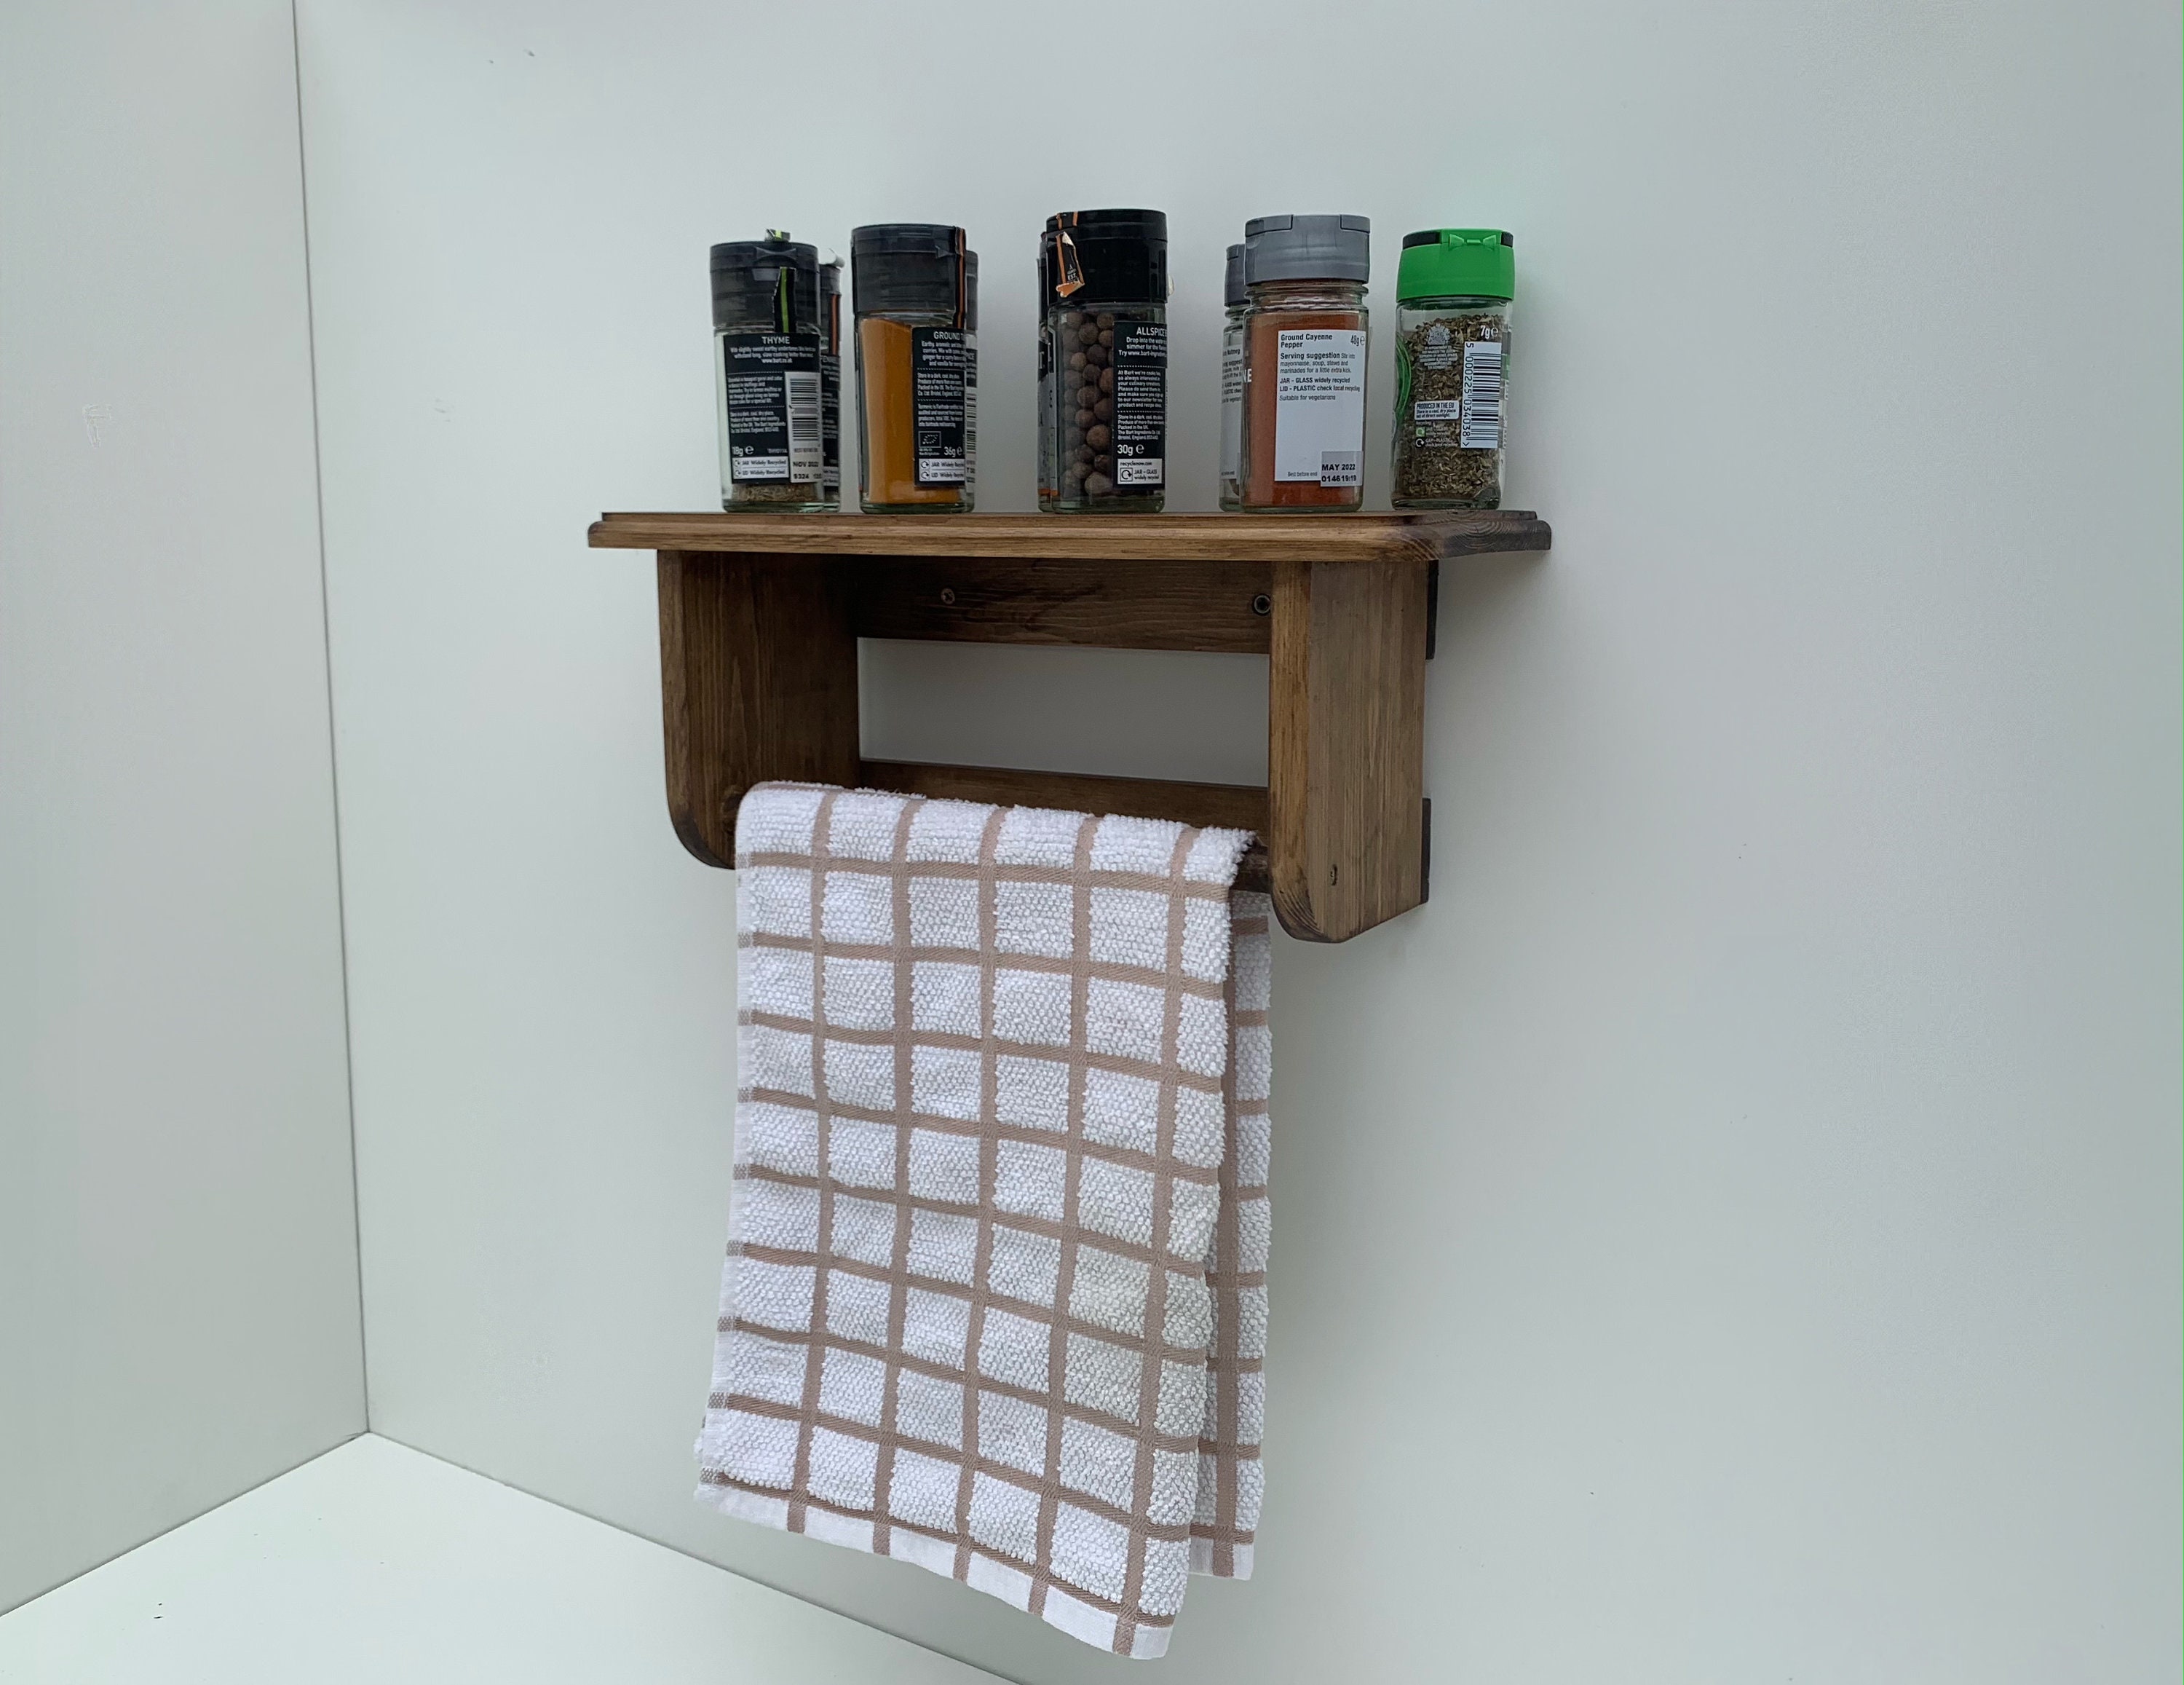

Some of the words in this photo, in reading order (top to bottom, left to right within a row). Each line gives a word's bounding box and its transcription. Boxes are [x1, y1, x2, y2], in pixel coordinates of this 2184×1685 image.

[933, 331, 960, 341] GROUND
[1305, 334, 1334, 342] Cayenne
[1481, 325, 1490, 340] 7g
[1350, 335, 1359, 347] 48g
[1306, 352, 1340, 360] suggestion
[943, 446, 956, 458] 36g
[1117, 444, 1133, 456] 30g
